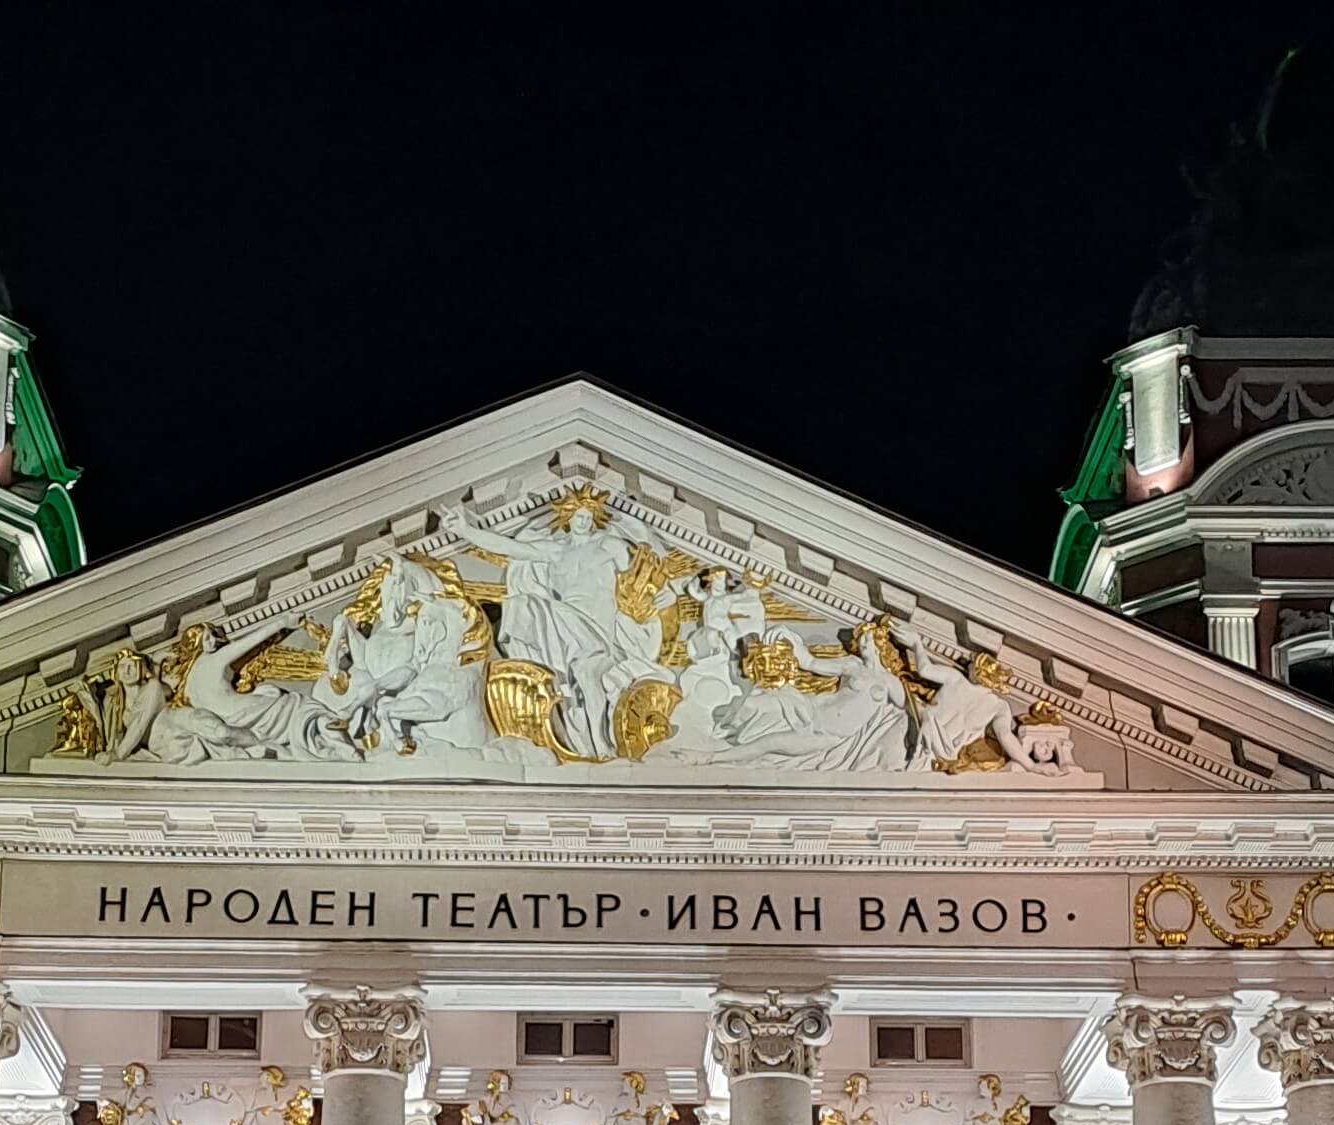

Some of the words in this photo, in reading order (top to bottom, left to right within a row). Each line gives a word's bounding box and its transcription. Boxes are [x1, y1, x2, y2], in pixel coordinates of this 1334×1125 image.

[98, 886, 377, 927] НАРОДЕН
[411, 891, 622, 930] ТЕАТЪР
[667, 893, 823, 932] ИВАН
[858, 896, 1049, 934] ВАЗОВ
